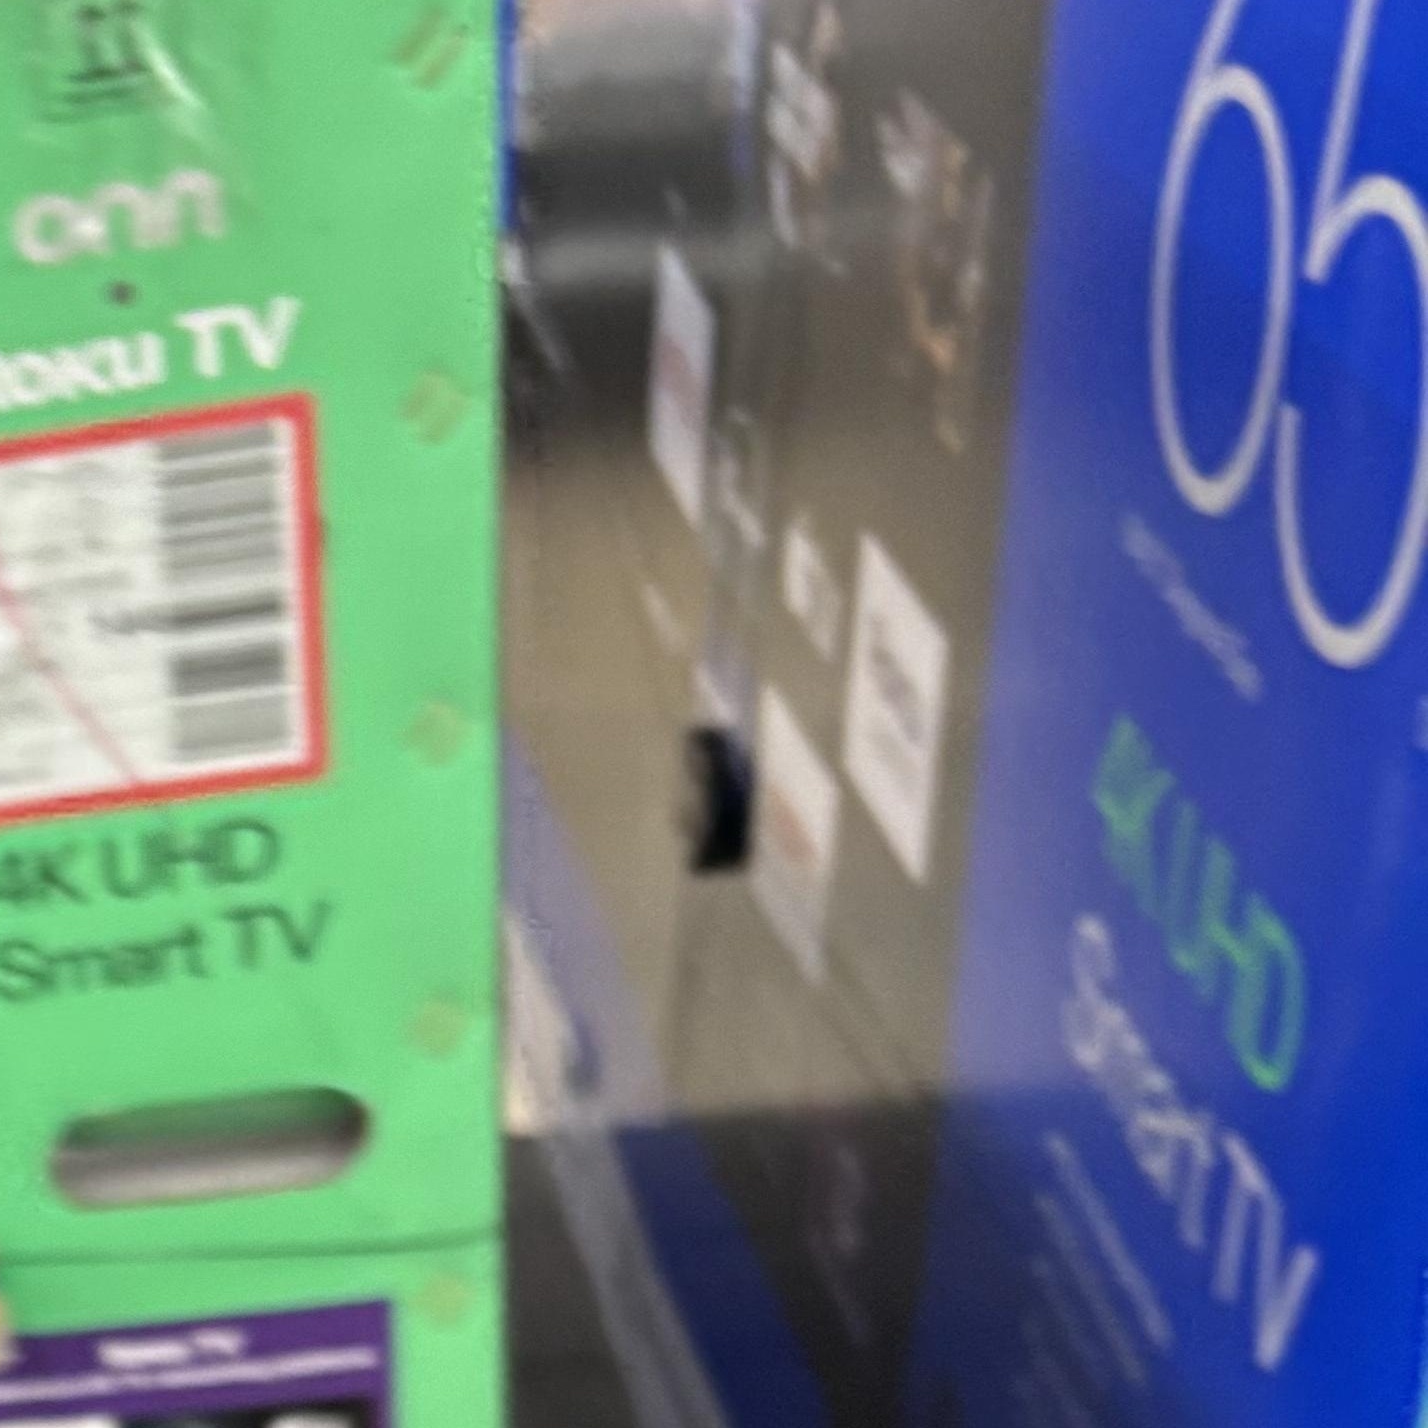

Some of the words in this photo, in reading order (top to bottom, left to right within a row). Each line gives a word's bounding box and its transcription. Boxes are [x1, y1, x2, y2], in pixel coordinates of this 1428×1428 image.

[170, 294, 304, 379] TV
[98, 816, 282, 900] UHD
[218, 898, 334, 972] TV
